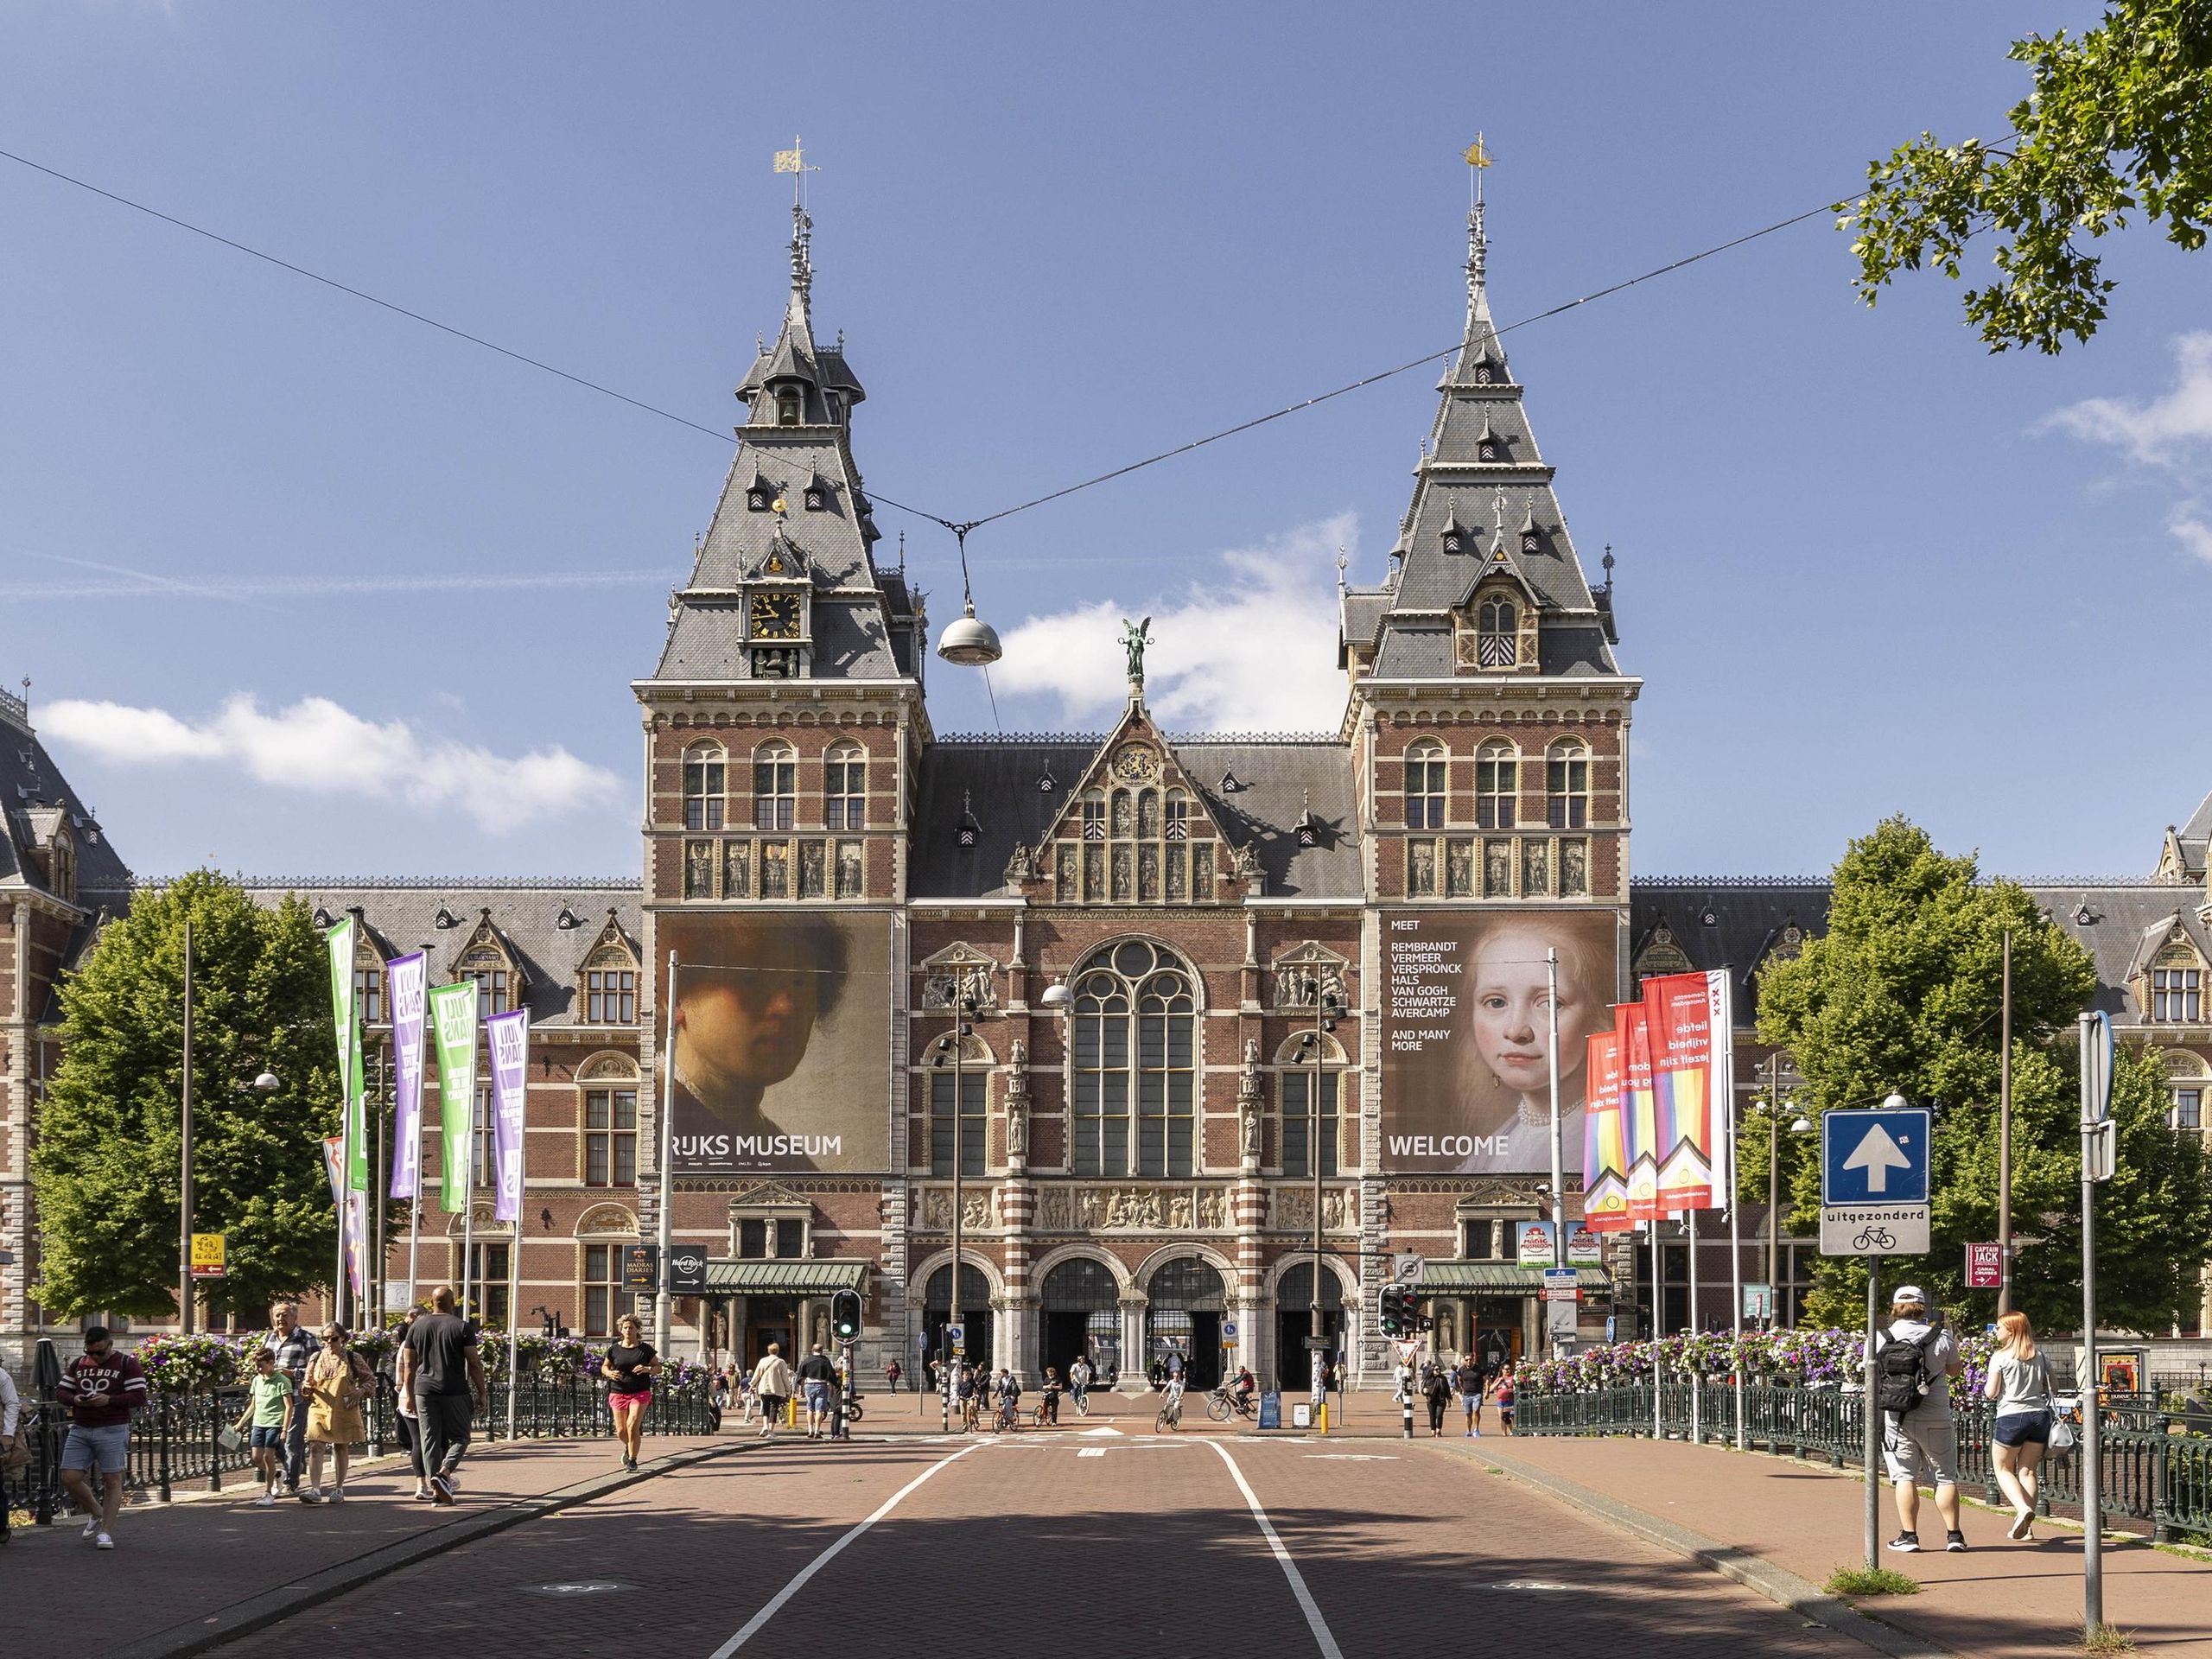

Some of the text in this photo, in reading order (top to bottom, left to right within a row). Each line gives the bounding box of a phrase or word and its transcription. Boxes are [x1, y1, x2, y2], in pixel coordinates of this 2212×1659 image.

[1391, 920, 1420, 931] MEET
[1391, 942, 1458, 952] REMBRANDT
[1391, 953, 1441, 963] VERMEER
[1391, 963, 1462, 974] VERSPRONCK
[1391, 975, 1420, 985] HALS
[1391, 985, 1448, 996] VAN GOGH
[1391, 996, 1456, 1007] SCHWARTZE
[1391, 1007, 1450, 1018] AVERCAMP
[1391, 1029, 1451, 1040] AND MANY
[1391, 1041, 1423, 1051] MORE
[735, 1135, 842, 1155] MUSEUM
[1389, 1135, 1509, 1156] WELCOME
[1827, 1210, 1924, 1224] uitgezonderd
[1974, 1252, 1998, 1262] JACK
[688, 1259, 703, 1268] Rock
[76, 1369, 120, 1379] SILBON
